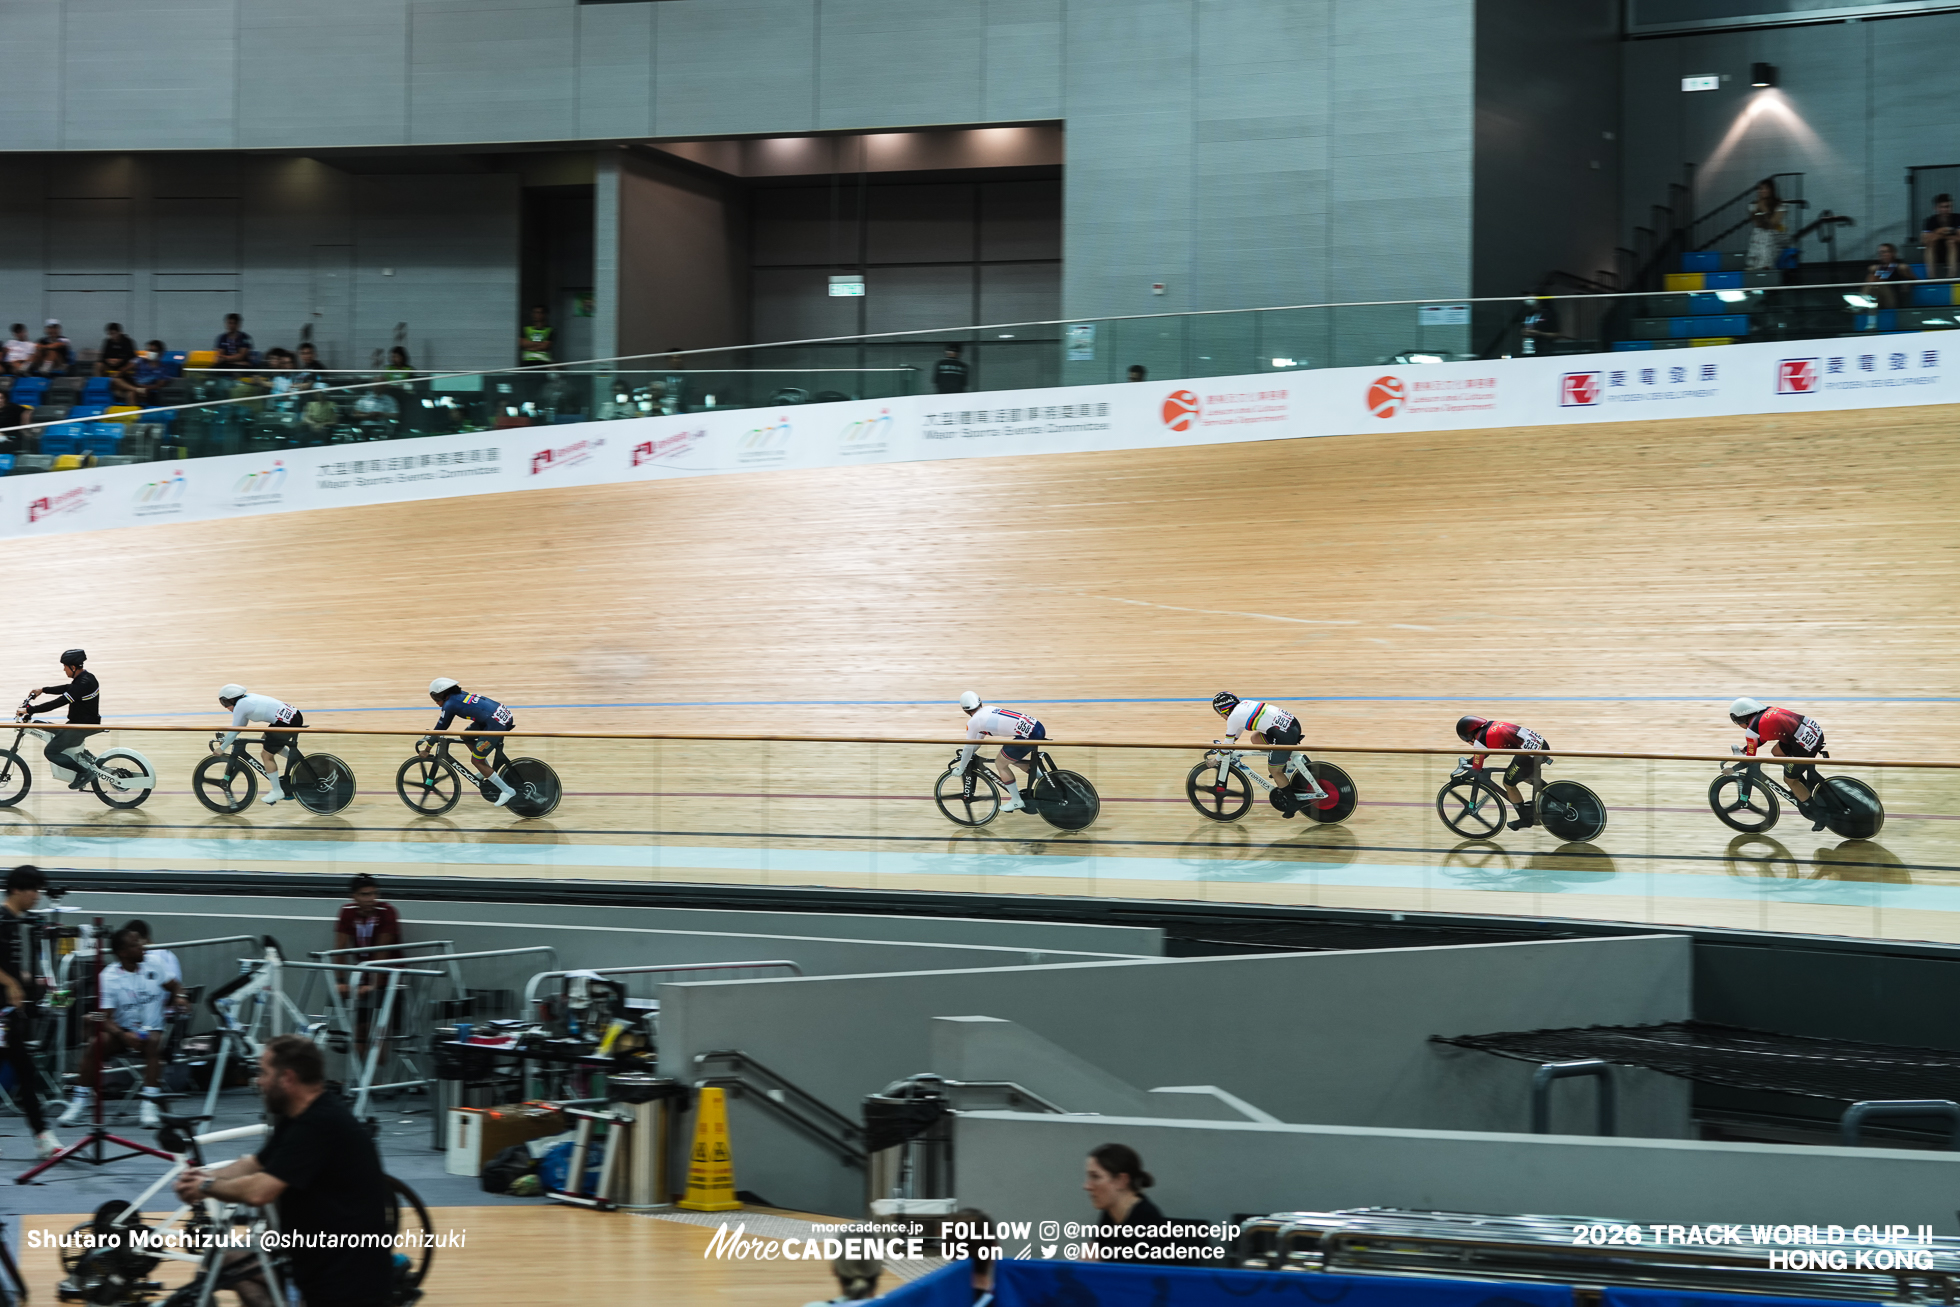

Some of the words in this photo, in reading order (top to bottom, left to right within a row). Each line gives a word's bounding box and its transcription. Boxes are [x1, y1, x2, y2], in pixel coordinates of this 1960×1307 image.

[279, 708, 292, 720] 419
[496, 709, 509, 722] 339
[1017, 720, 1032, 734] 358
[1275, 715, 1290, 729] 393
[1801, 731, 1817, 746] 337
[452, 762, 481, 787] KOGA
[964, 776, 972, 798] LOTUS
[1764, 779, 1799, 806] KOGA
